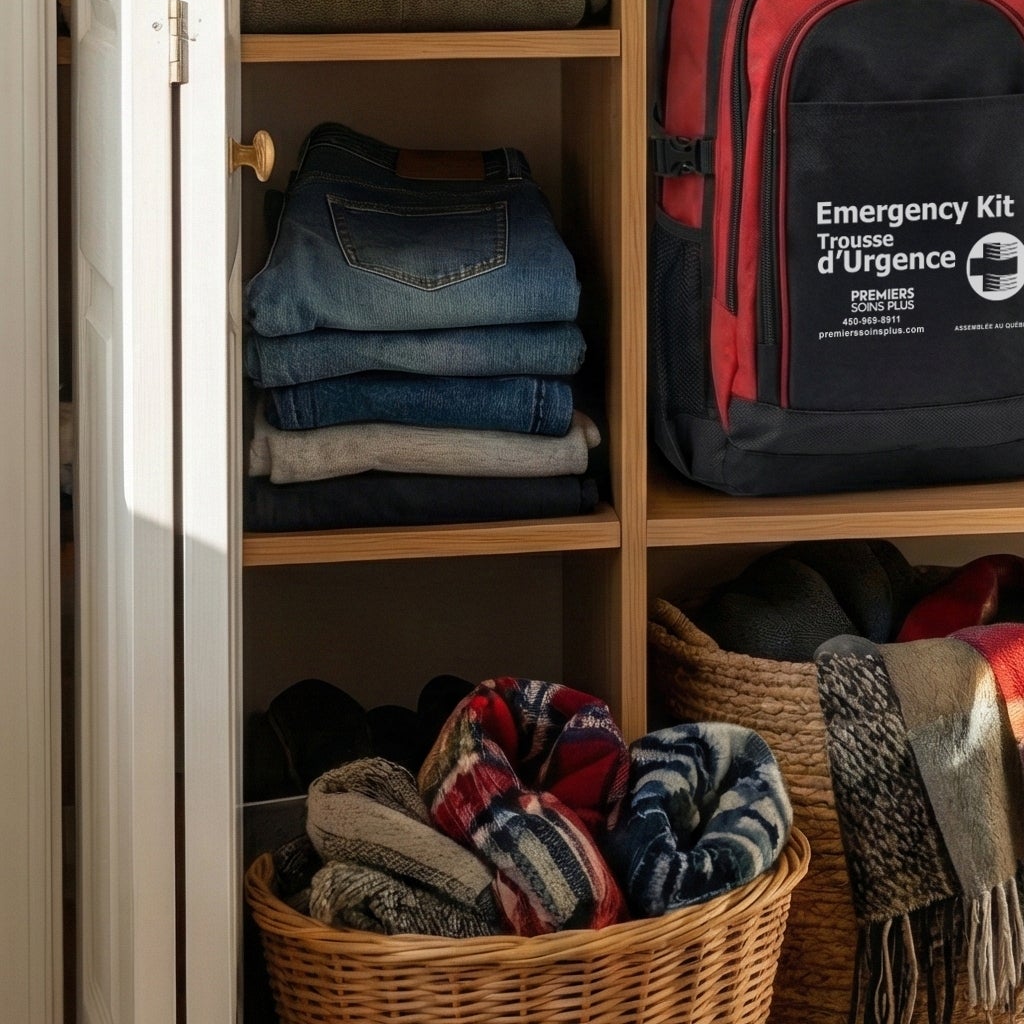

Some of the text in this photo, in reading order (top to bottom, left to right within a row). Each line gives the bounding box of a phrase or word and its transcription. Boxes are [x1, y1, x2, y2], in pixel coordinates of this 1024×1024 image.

[817, 194, 1015, 227] Emergency Kit
[817, 233, 894, 250] Trousse
[851, 288, 914, 301] PREMIERS
[851, 299, 915, 313] SOINS PLUS
[842, 316, 901, 326] 450-969-8911
[818, 325, 925, 340] premierssoinsplus.com
